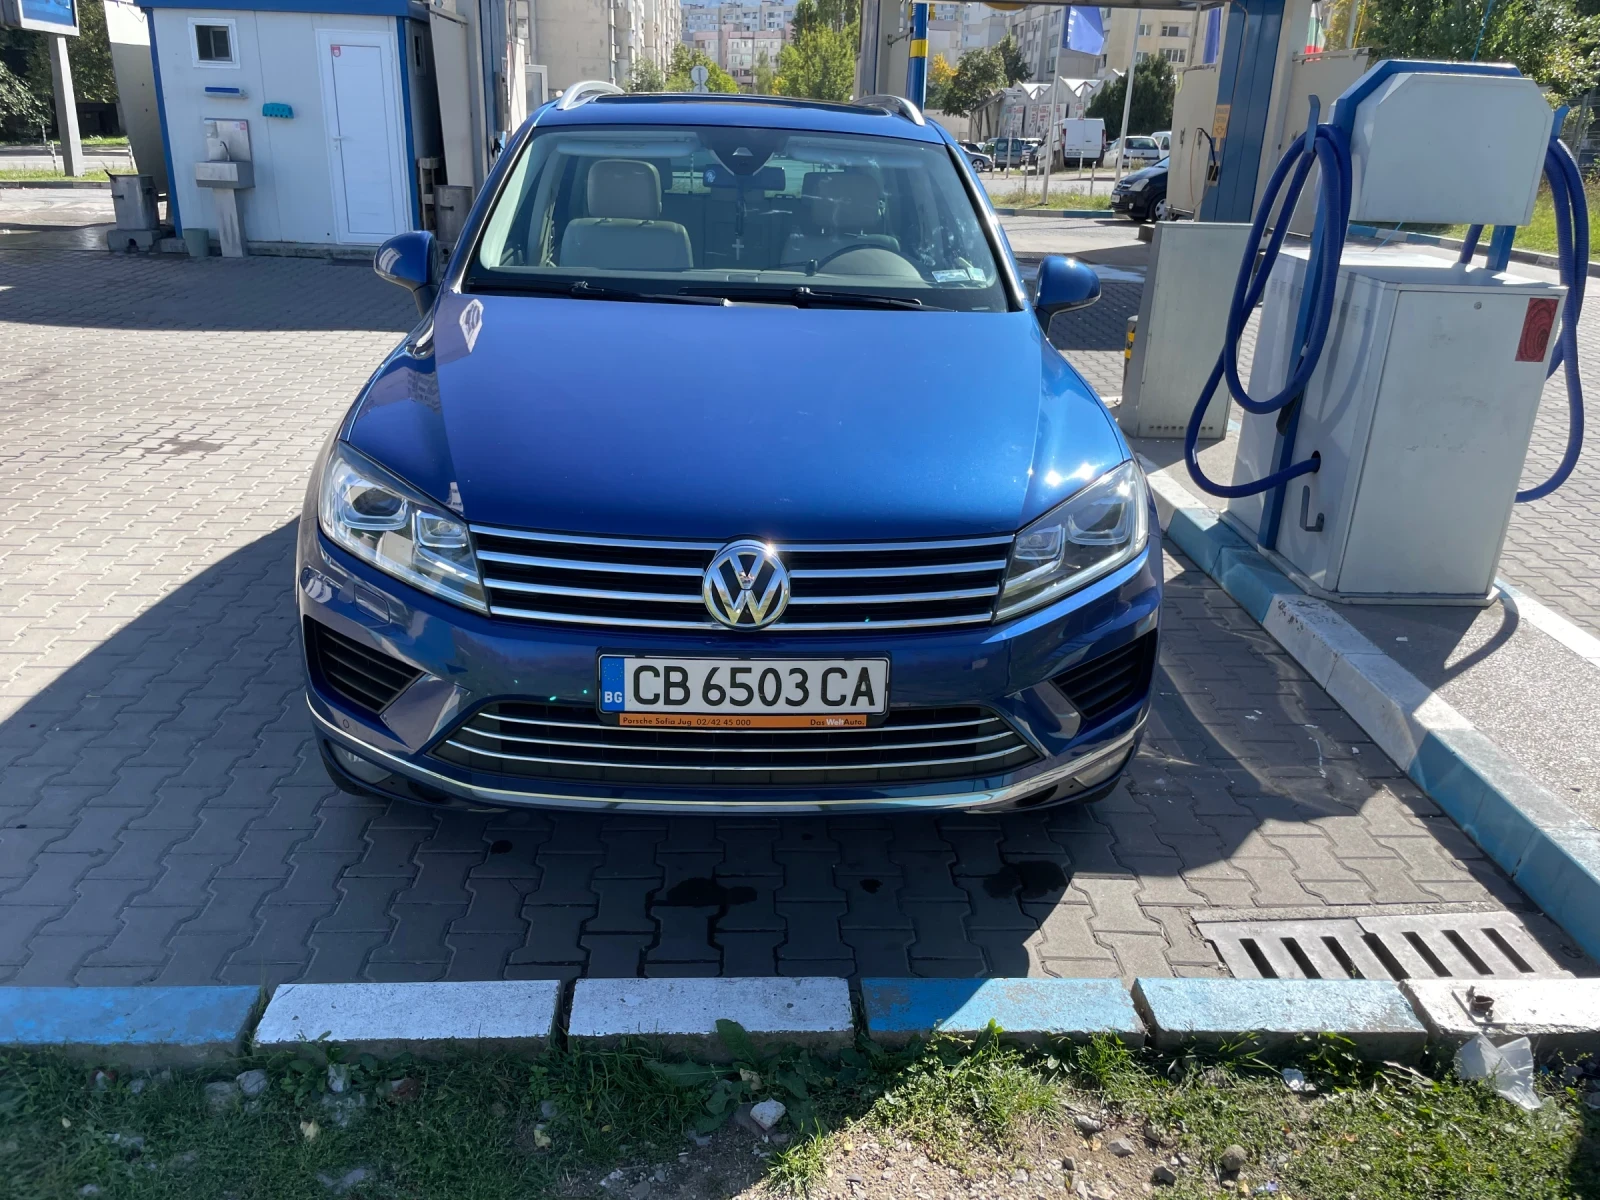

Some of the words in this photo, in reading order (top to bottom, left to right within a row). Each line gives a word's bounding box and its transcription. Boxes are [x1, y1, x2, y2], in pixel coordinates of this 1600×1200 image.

[705, 546, 787, 628] VW
[604, 691, 623, 703] BG
[633, 665, 691, 706] CB
[702, 667, 809, 707] 6503
[820, 667, 876, 707] CA
[622, 717, 653, 725] Porsche
[678, 718, 692, 727] Jug
[696, 718, 721, 726] 02/42
